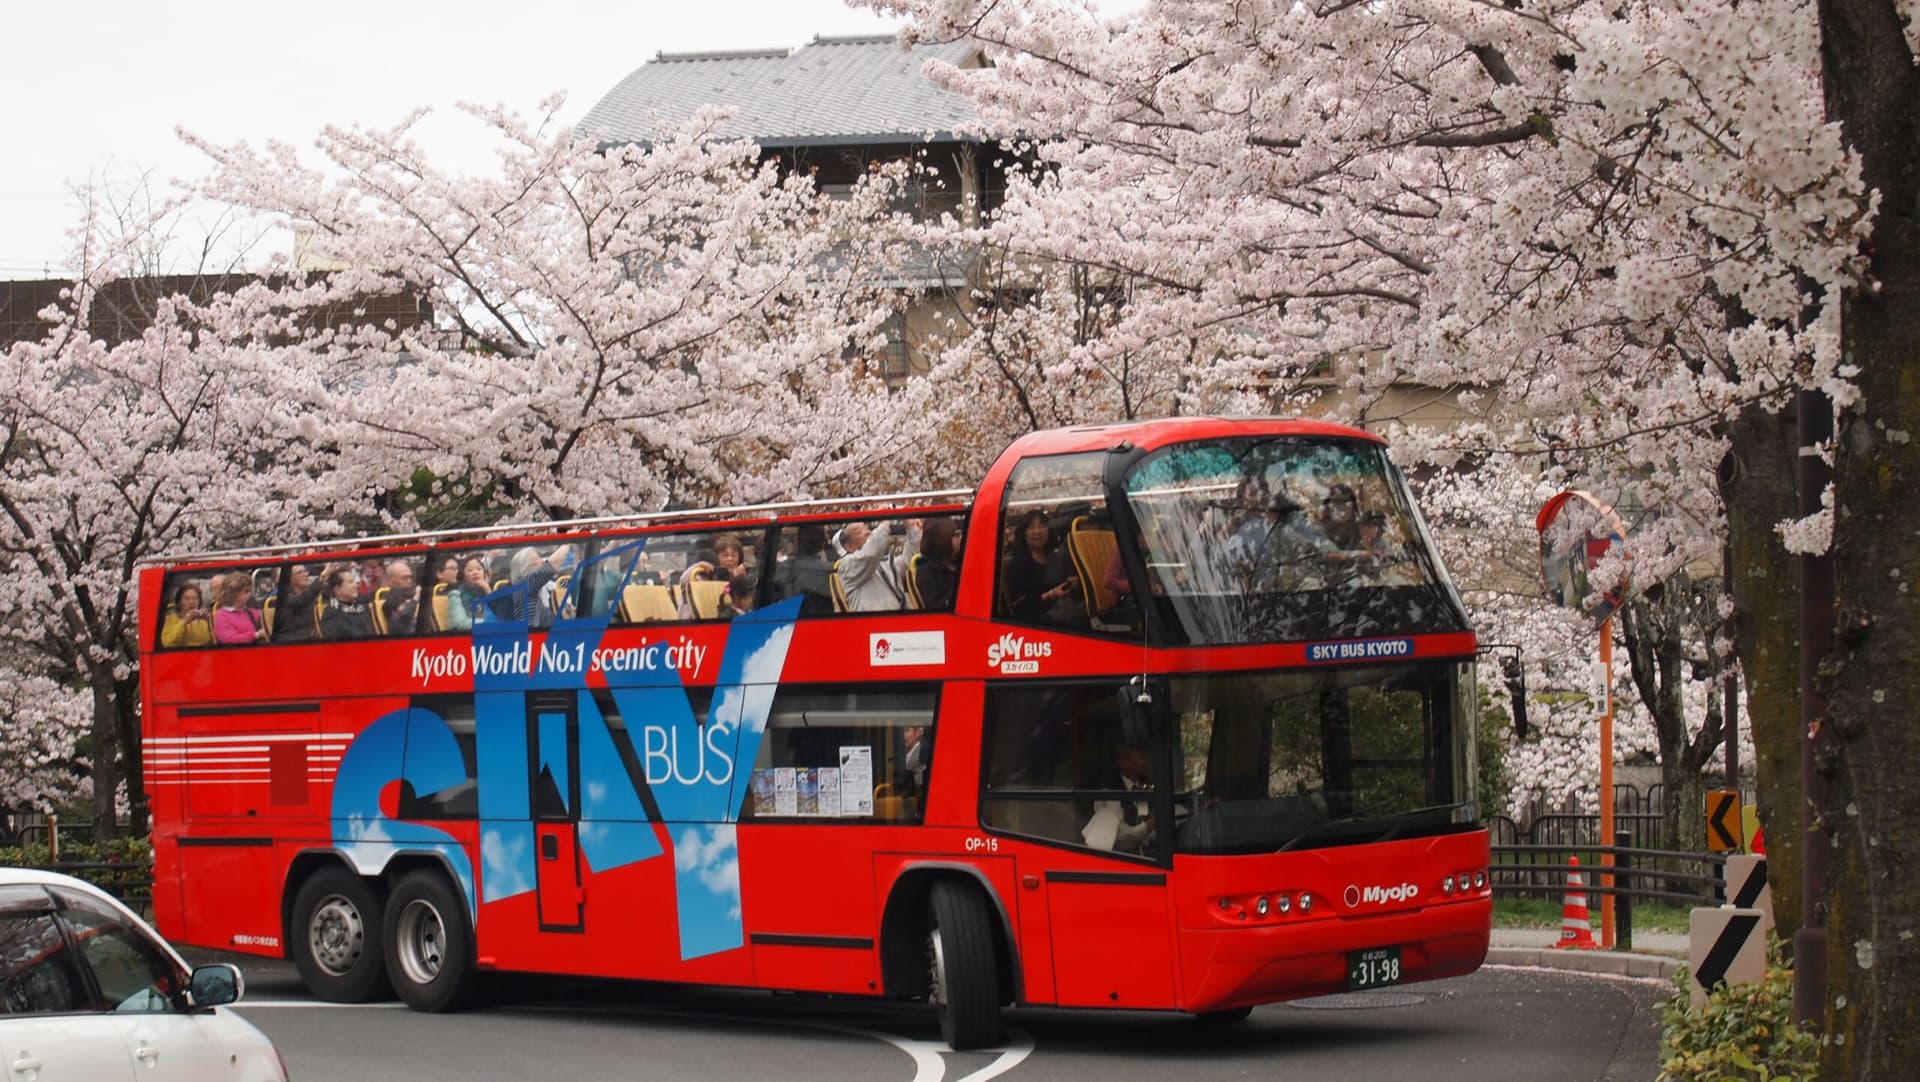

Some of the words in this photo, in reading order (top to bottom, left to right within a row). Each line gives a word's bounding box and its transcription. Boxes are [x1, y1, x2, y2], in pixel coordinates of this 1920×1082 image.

[411, 648, 466, 687] Kyoto
[471, 641, 532, 676] World
[539, 642, 585, 673] No.1
[591, 637, 659, 672] scenic
[664, 635, 706, 679] city
[988, 632, 1024, 667] SKY
[1024, 641, 1052, 657] BUS
[1313, 645, 1338, 660] SKY
[1340, 643, 1365, 658] BUS
[1367, 640, 1407, 656] KYOTO
[644, 724, 733, 785] BUS
[965, 837, 998, 852] OP-15
[1363, 882, 1418, 904] Myojo
